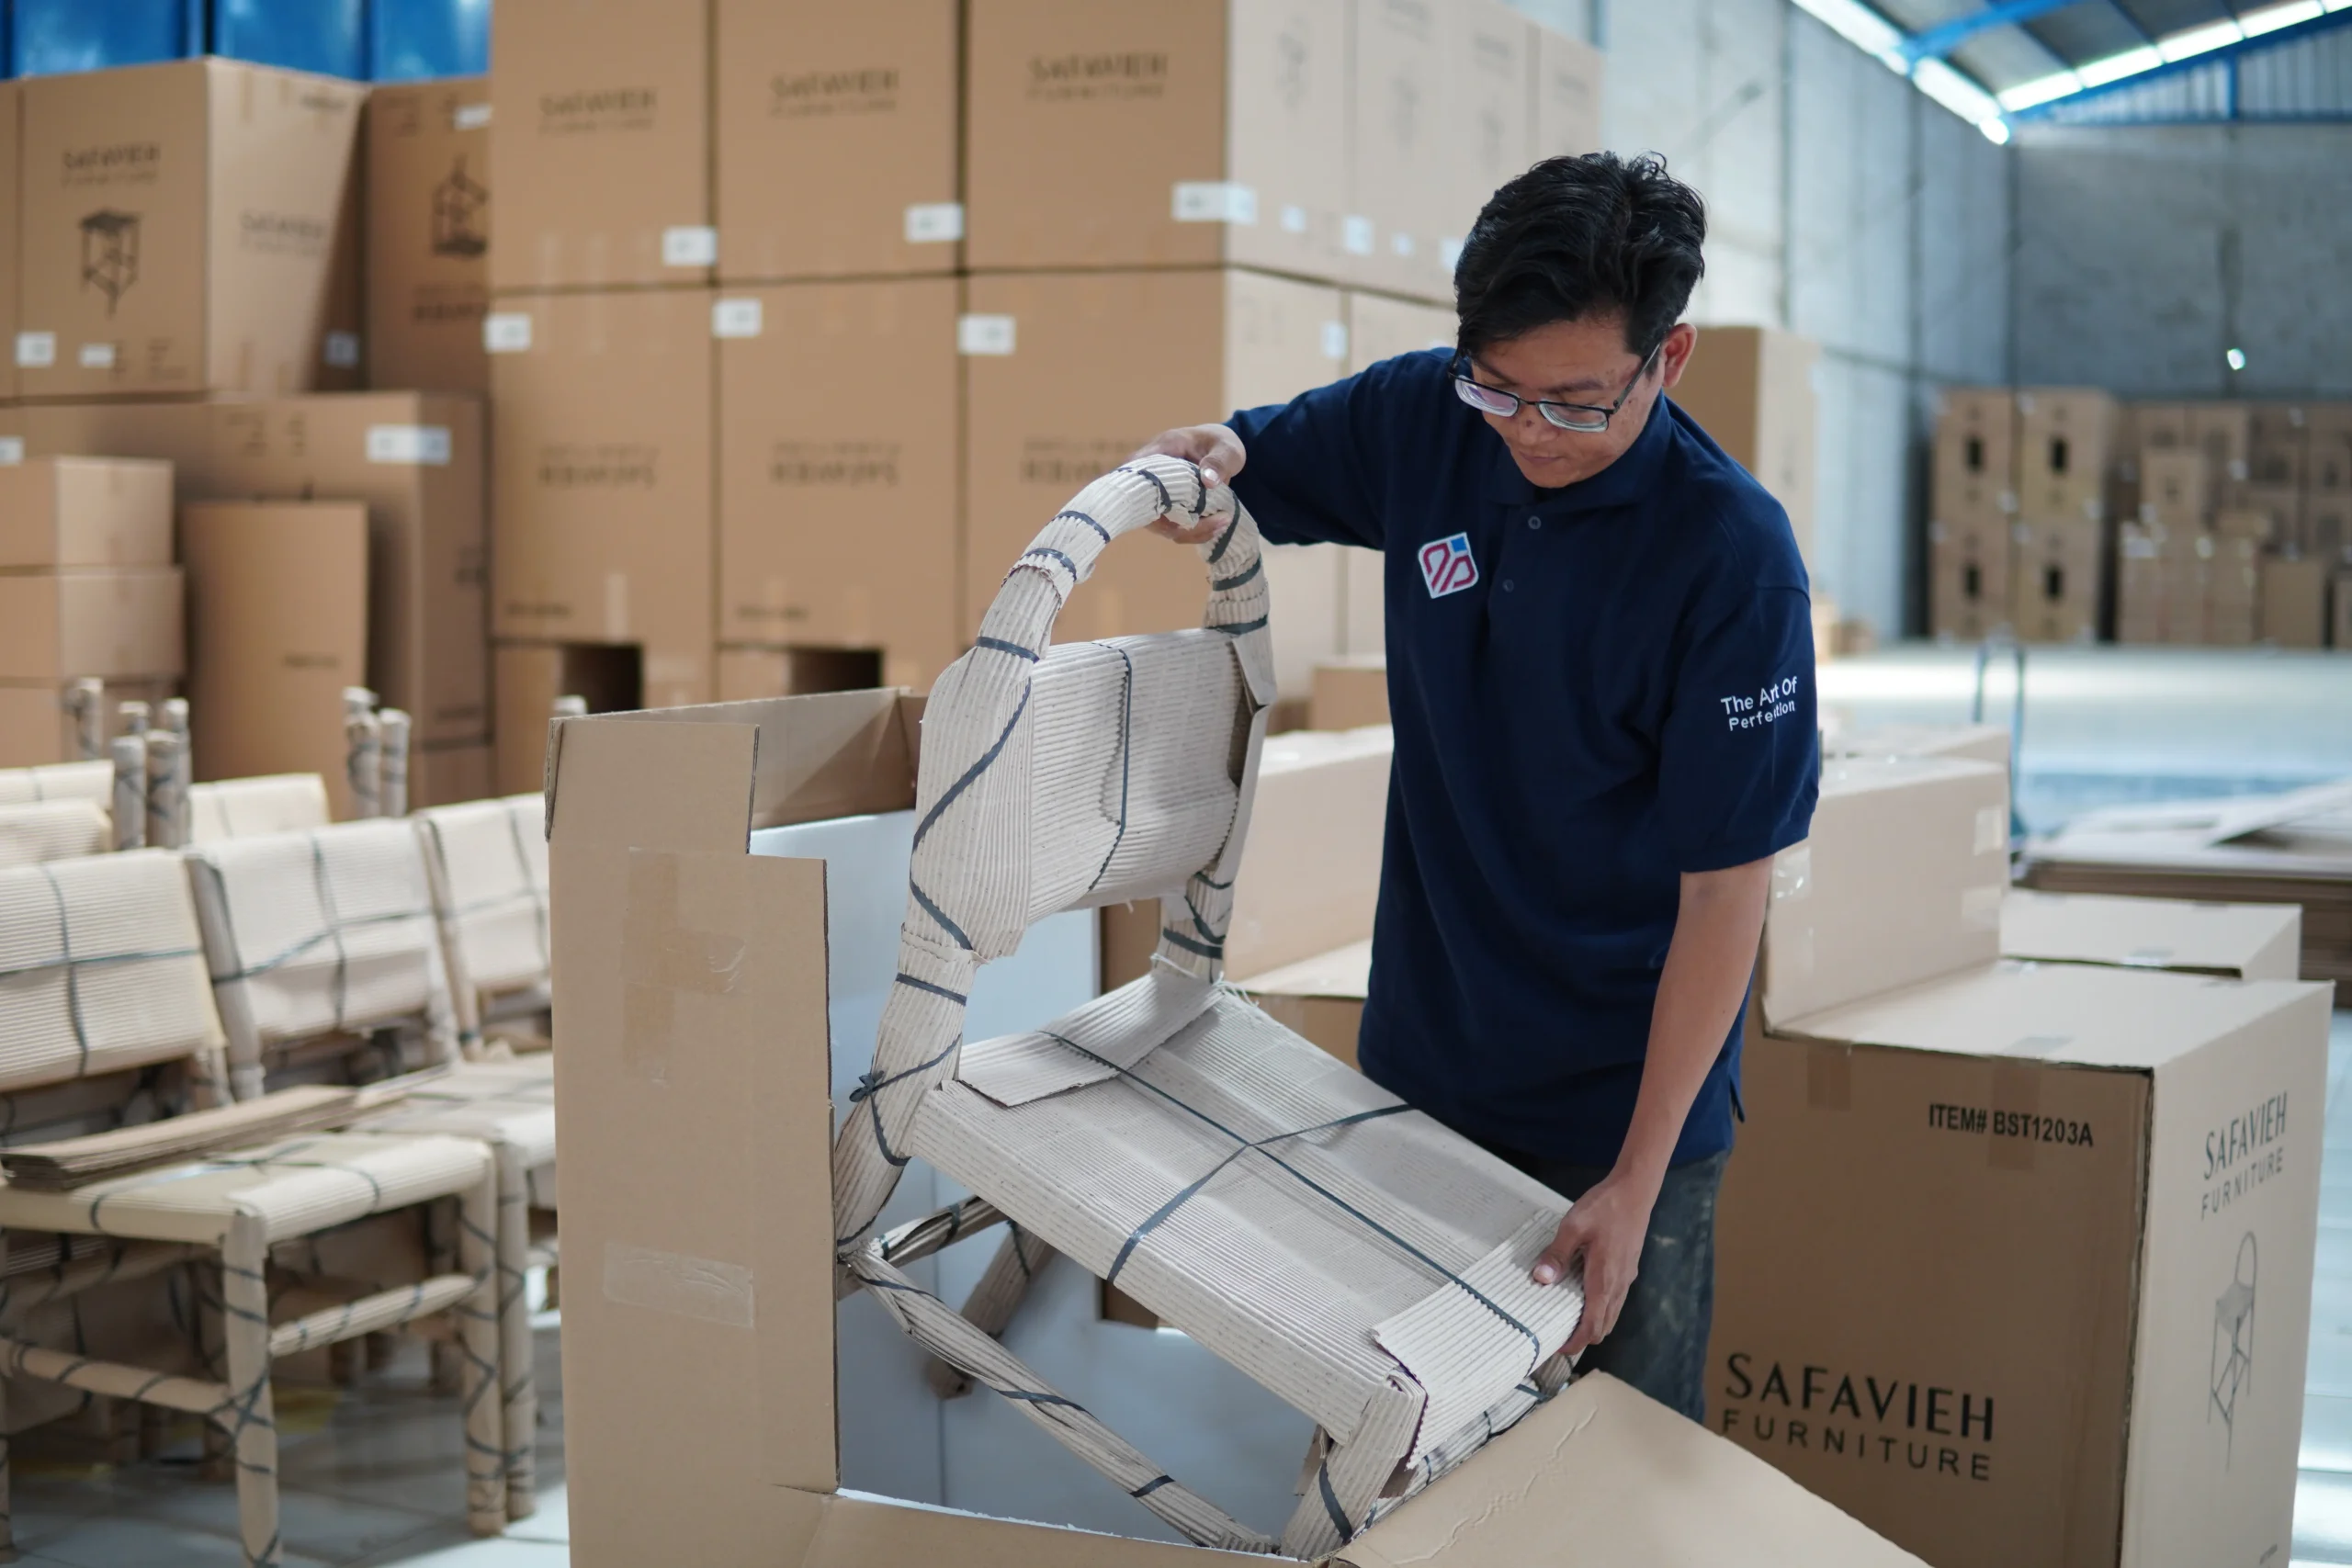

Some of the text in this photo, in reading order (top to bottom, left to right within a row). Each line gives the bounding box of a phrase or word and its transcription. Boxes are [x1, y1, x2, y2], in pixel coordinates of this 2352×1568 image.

[1720, 675, 1798, 716] The Art Of
[1928, 1104, 2094, 1147] ITEM# BST1203A
[2204, 1090, 2287, 1180] SAFAVIEH
[2201, 1145, 2284, 1222] FURNITURE
[1724, 1352, 1994, 1442] SAFAVIEH
[1722, 1408, 1992, 1482] FURNITURE
